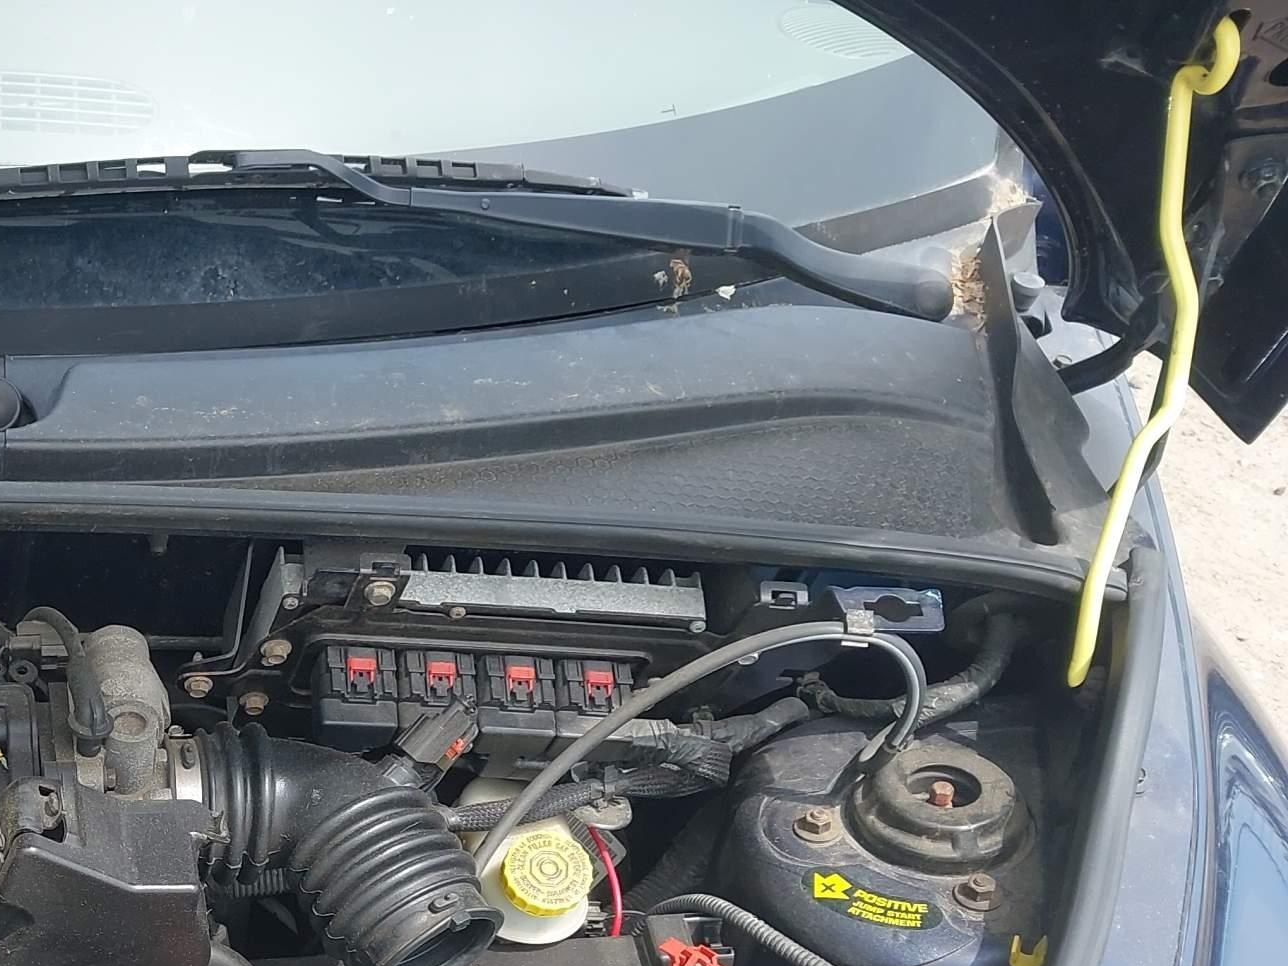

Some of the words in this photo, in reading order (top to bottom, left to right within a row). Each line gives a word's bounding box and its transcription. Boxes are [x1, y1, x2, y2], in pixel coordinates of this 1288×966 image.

[852, 888, 929, 913] POSITIVE
[852, 900, 886, 915] JUMP
[886, 909, 922, 921] START
[847, 906, 922, 928] ATTACHMENT
